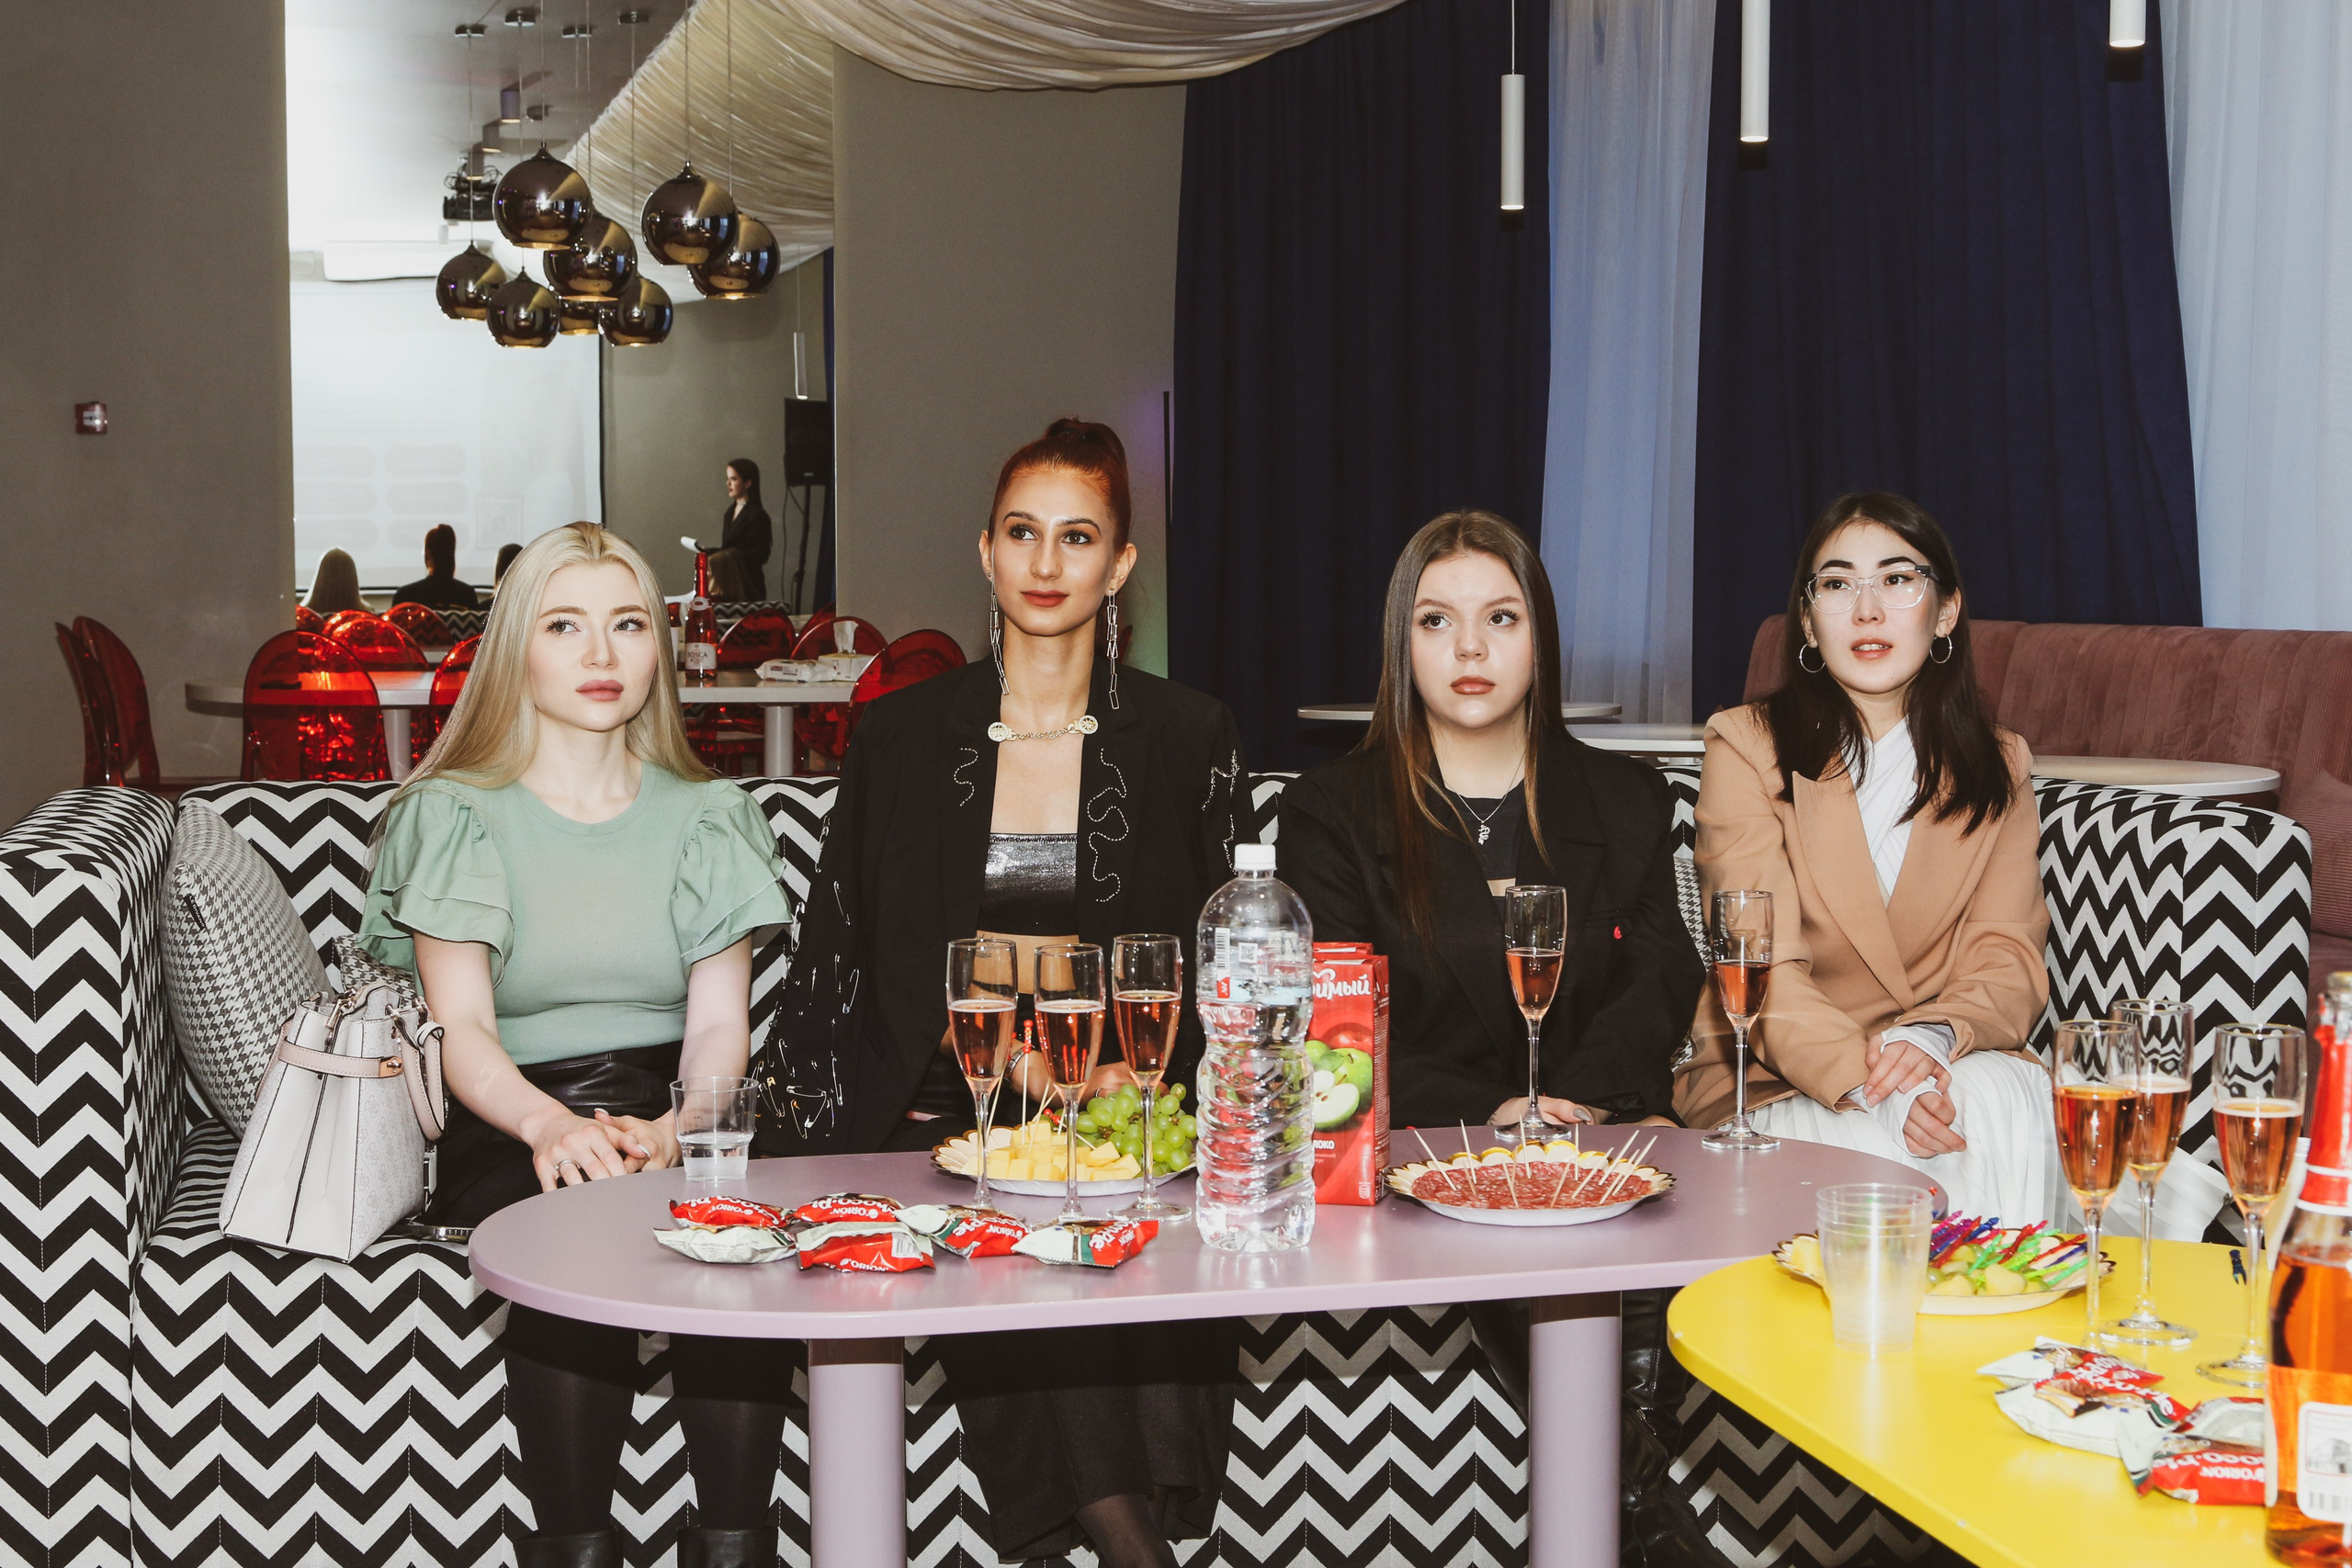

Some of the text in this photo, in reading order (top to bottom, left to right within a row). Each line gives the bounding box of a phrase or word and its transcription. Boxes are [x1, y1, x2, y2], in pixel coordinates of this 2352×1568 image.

[1313, 1140, 1335, 1150] ЛОКО
[831, 1206, 867, 1217] ORION
[988, 1224, 1016, 1237] ORION
[850, 1258, 886, 1272] ORION
[2199, 1466, 2254, 1481] ORION
